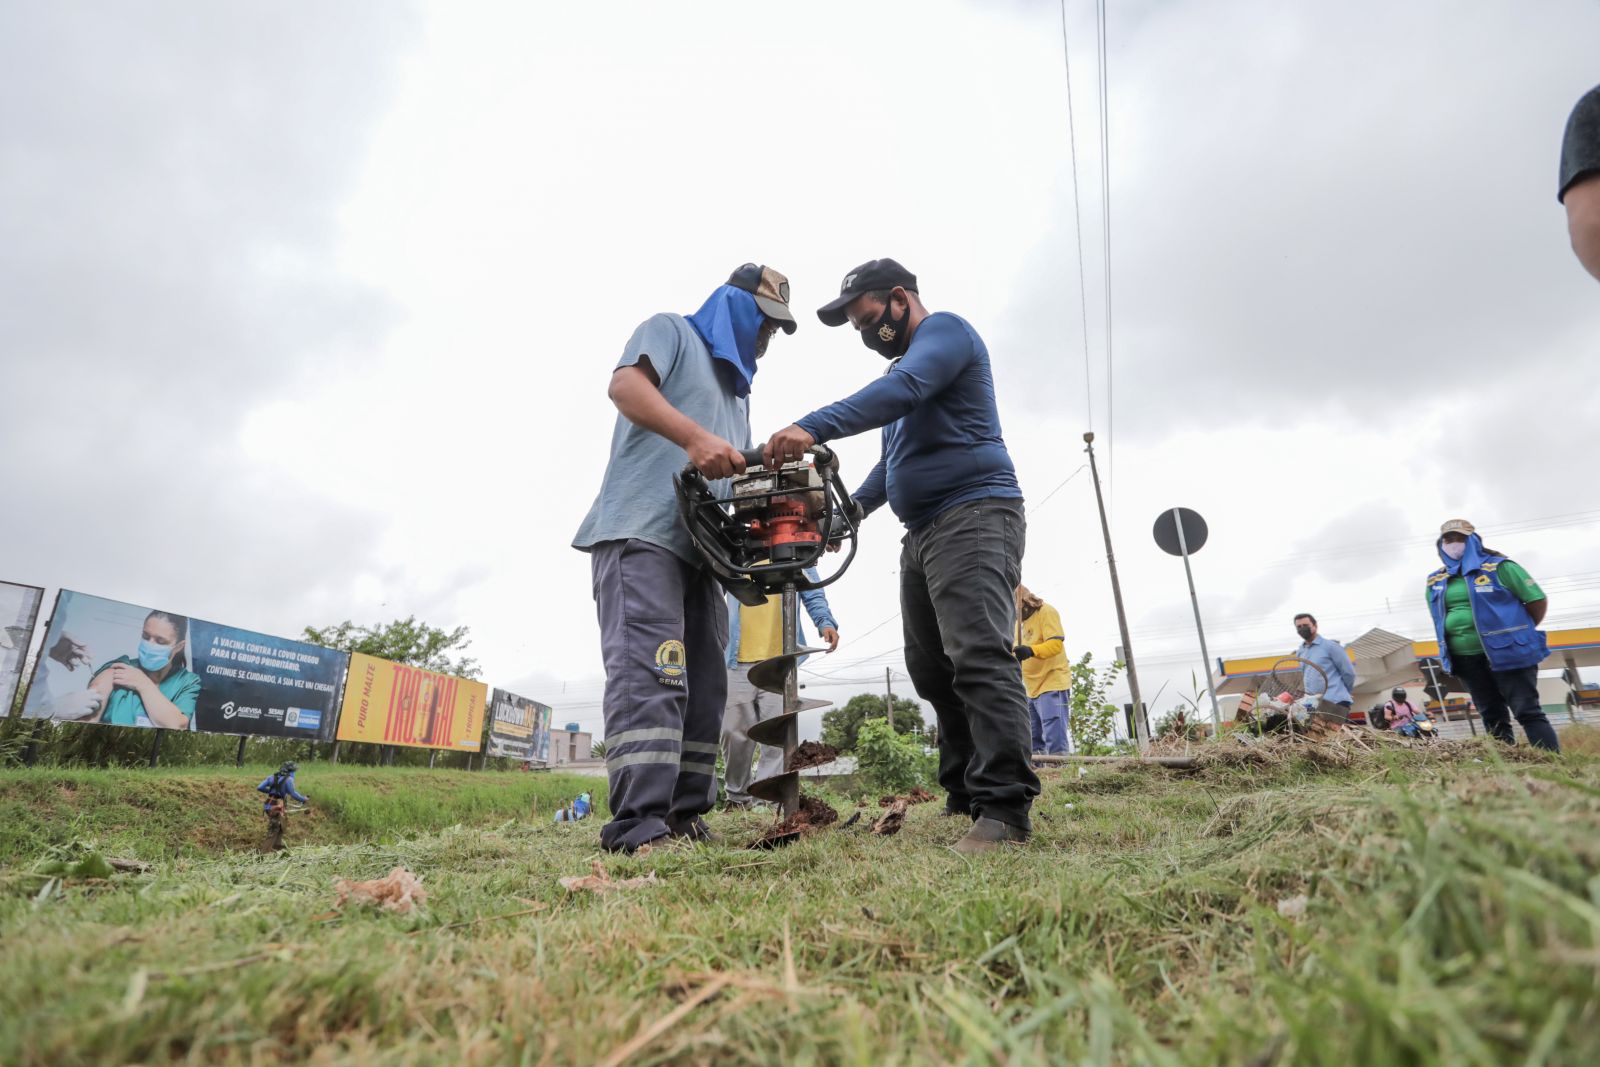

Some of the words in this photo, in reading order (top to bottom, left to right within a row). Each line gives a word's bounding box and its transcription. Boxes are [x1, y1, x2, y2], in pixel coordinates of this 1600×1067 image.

[210, 648, 230, 659] PARA
[231, 652, 236, 660] O
[238, 653, 260, 664] GRUPO
[213, 637, 218, 645] A
[220, 638, 245, 650] VACINA
[246, 643, 271, 655] CONTRA
[278, 649, 296, 660] COVID
[297, 653, 320, 664] CHEGOU
[206, 665, 238, 678] CONTINUE
[238, 670, 246, 679] SE
[246, 671, 276, 684] CUIDANDO,
[283, 678, 293, 686] SUA
[294, 680, 304, 688] VEZ
[305, 681, 314, 690] VAI
[659, 678, 684, 686] SEMA
[358, 700, 369, 728] PURO
[364, 663, 376, 698] MALTE
[238, 706, 262, 714] AGEVISA
